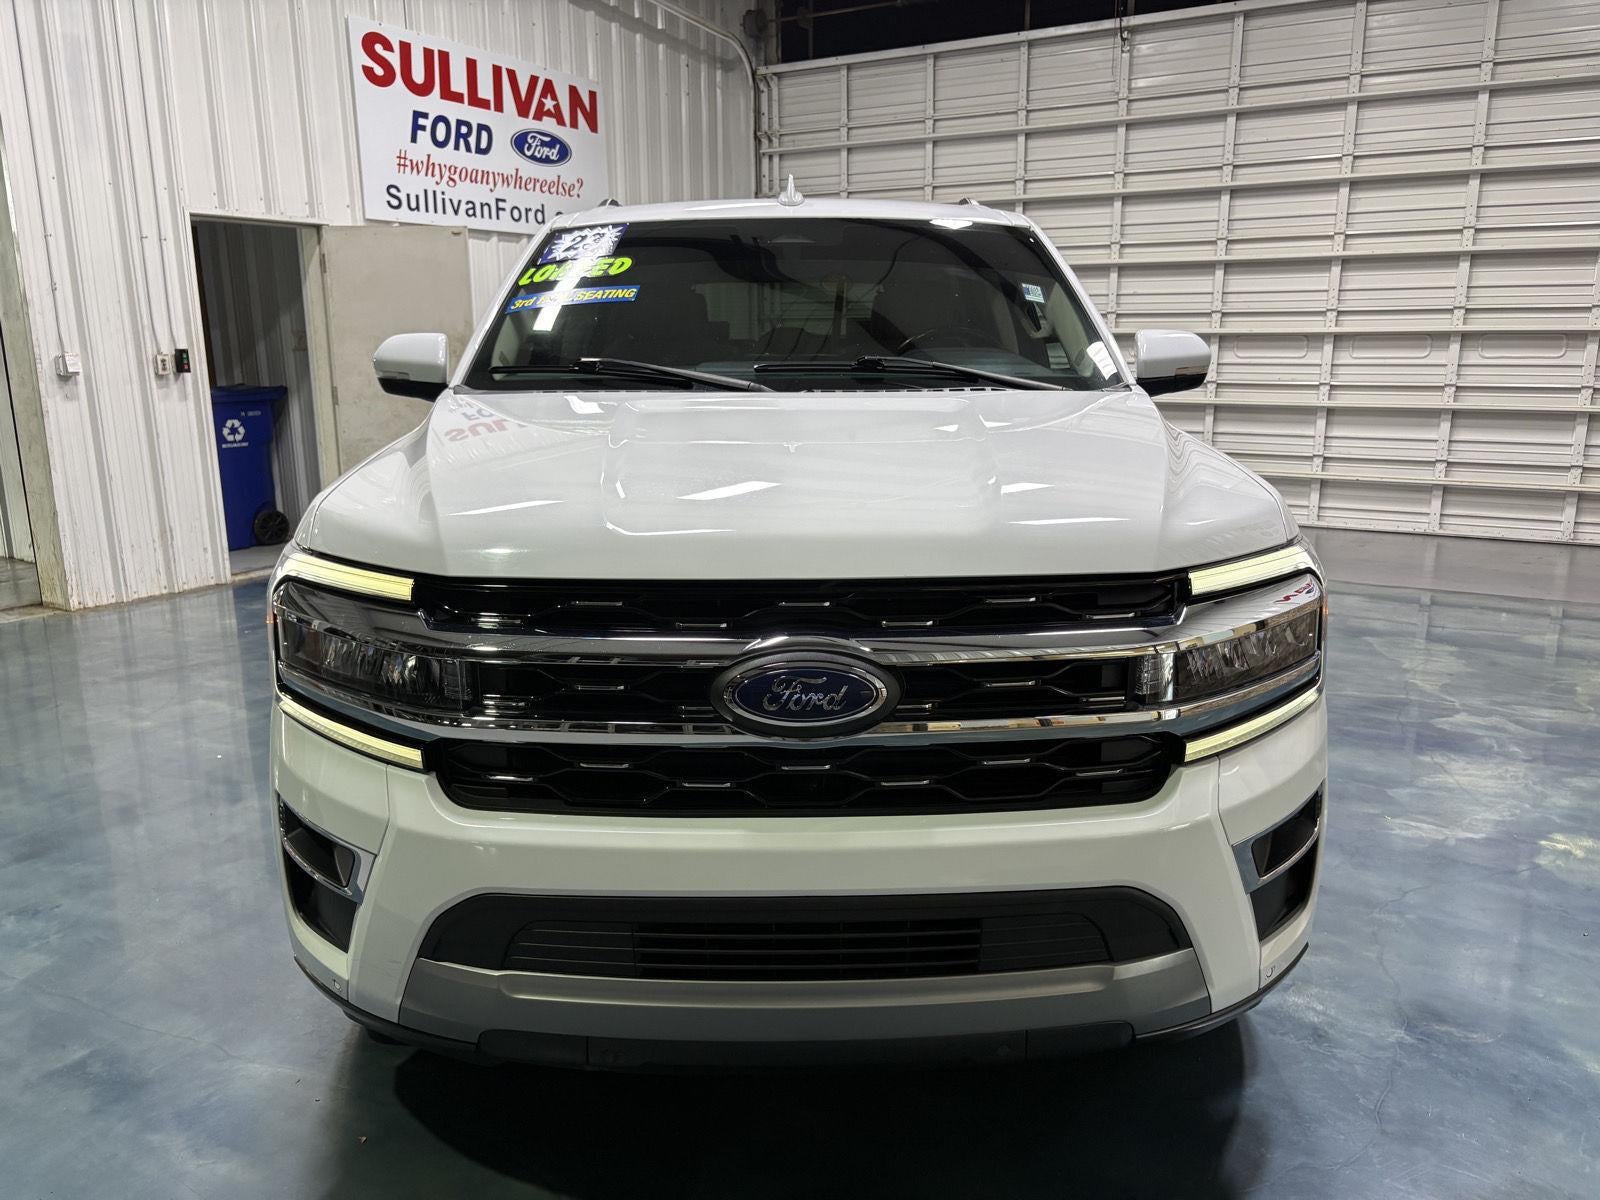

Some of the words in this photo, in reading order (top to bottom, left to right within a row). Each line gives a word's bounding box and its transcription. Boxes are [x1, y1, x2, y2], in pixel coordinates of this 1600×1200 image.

[361, 31, 598, 134] SULLIVAN
[410, 110, 493, 156] FORD
[524, 132, 560, 162] Ford
[396, 148, 584, 199] #whygoanywhereelse?
[518, 256, 633, 286] LOAED
[511, 299, 535, 310] 3rd
[577, 288, 638, 302] SEATING
[762, 675, 849, 711] Ford
